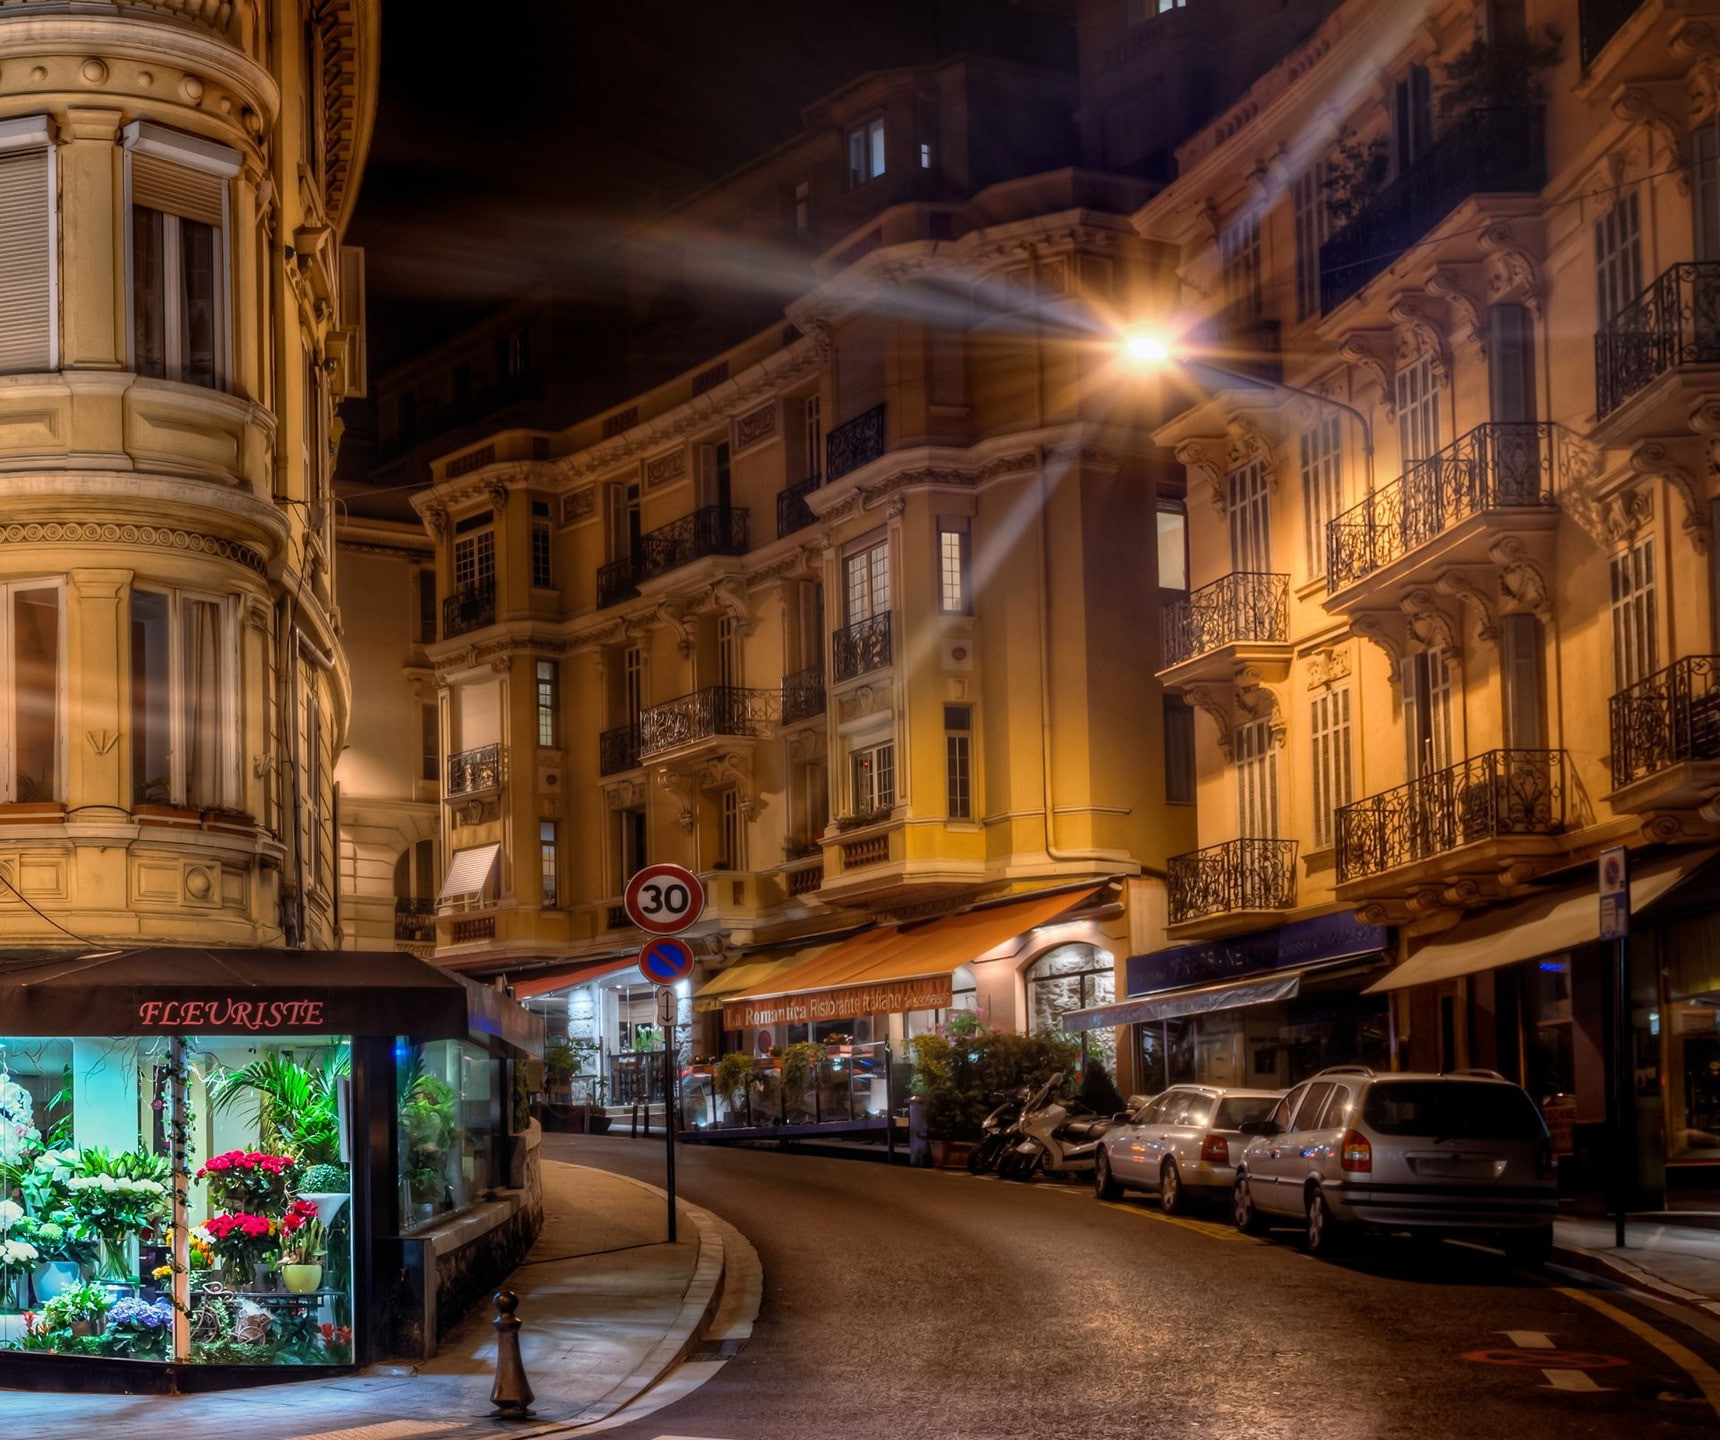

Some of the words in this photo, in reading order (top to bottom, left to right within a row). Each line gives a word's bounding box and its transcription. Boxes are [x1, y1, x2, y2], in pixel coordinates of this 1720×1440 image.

[641, 883, 689, 914] 30
[139, 998, 324, 1030] FLEURISTE
[745, 1001, 807, 1026] Romantica
[810, 996, 860, 1018] Ristorante
